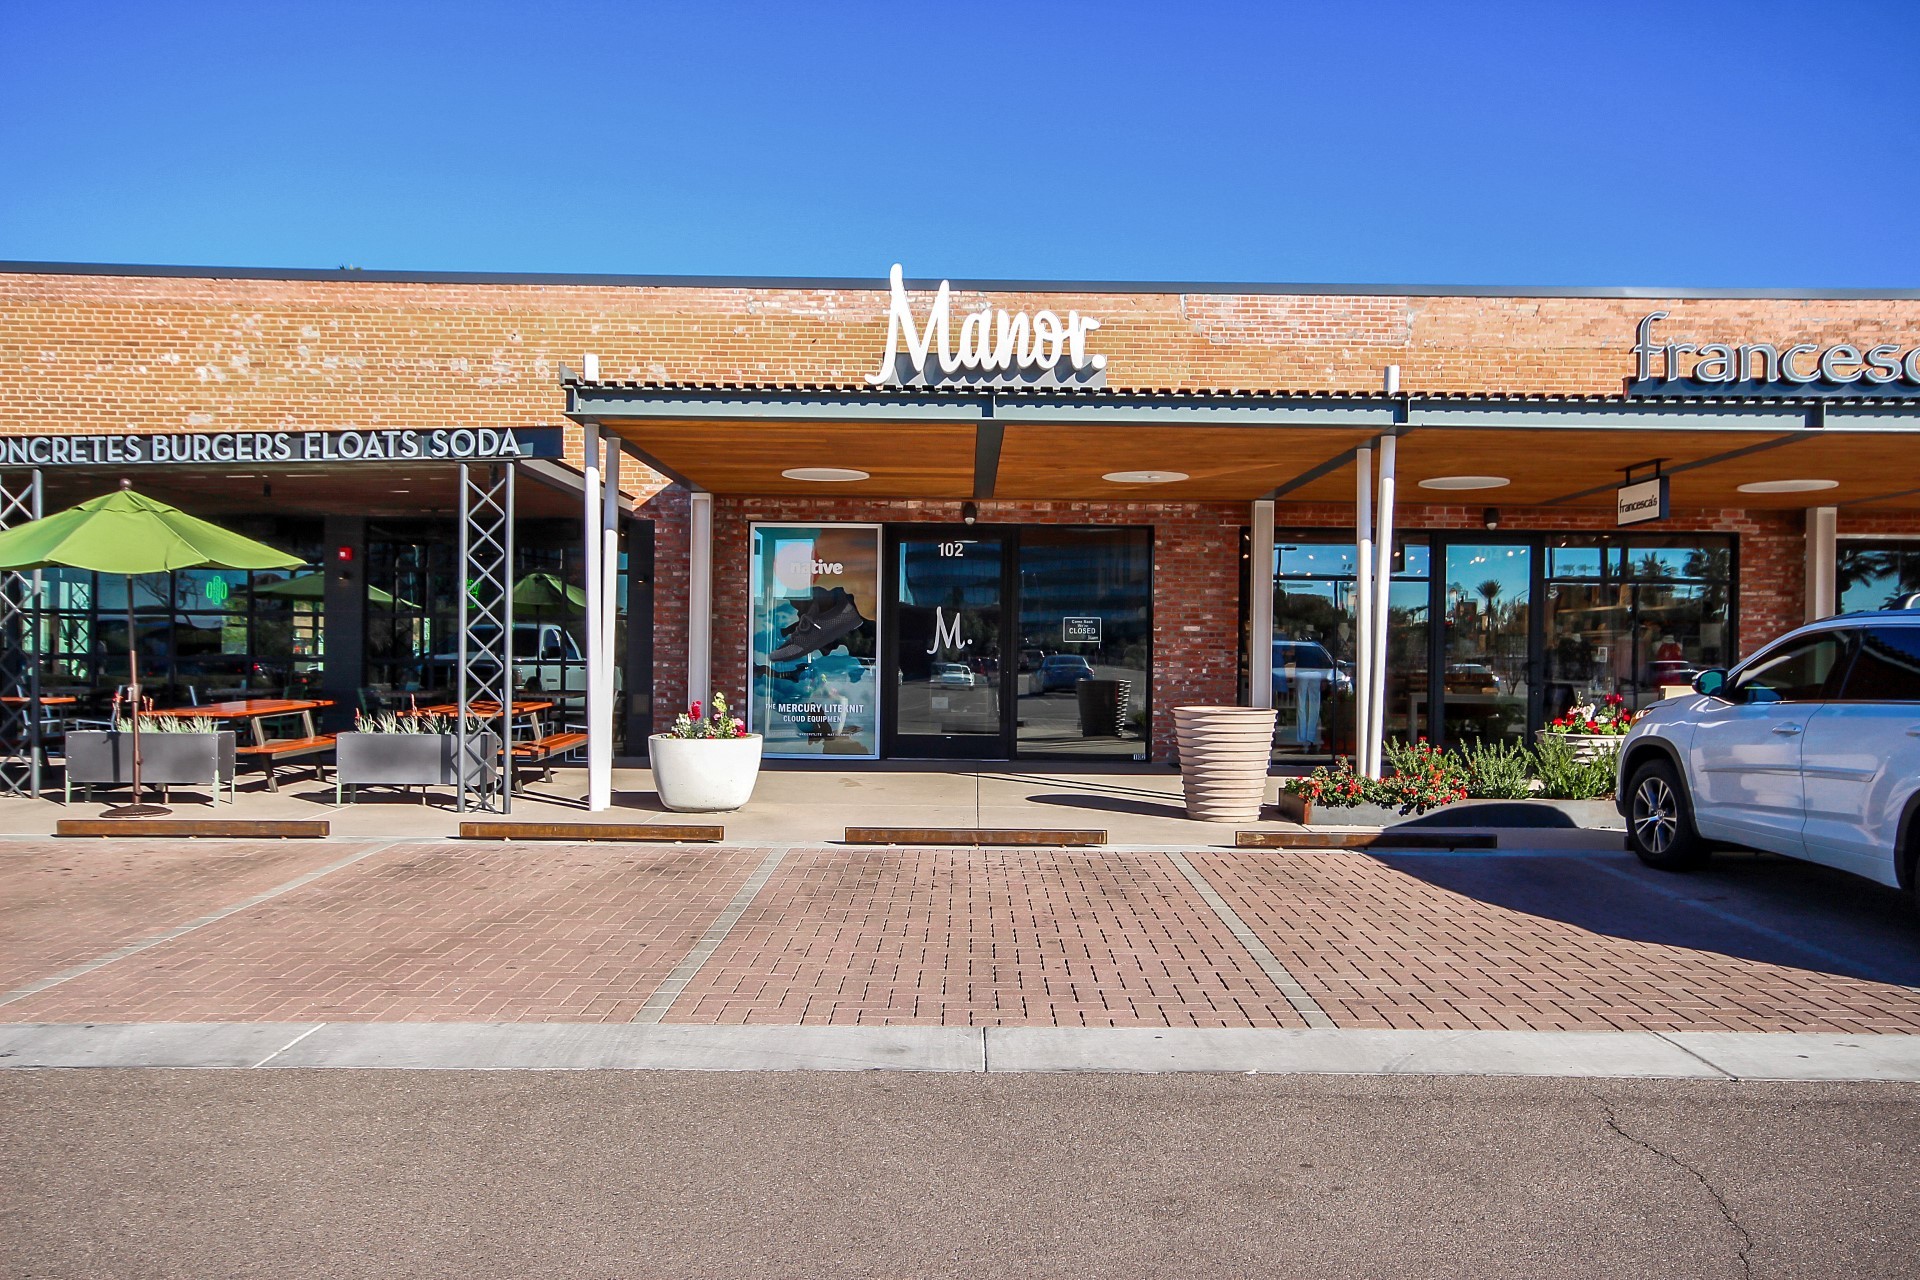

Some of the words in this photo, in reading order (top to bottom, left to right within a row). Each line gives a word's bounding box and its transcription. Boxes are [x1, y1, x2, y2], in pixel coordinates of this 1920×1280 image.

[864, 263, 1106, 385] Manor.
[0, 436, 142, 463] NCRETES
[152, 433, 291, 462] BURGERS
[304, 430, 418, 460] FLOATS
[431, 427, 521, 457] SODA
[1619, 494, 1658, 514] francesca's
[938, 543, 964, 557] 102
[790, 558, 844, 575] native
[778, 703, 821, 713] MERCURY
